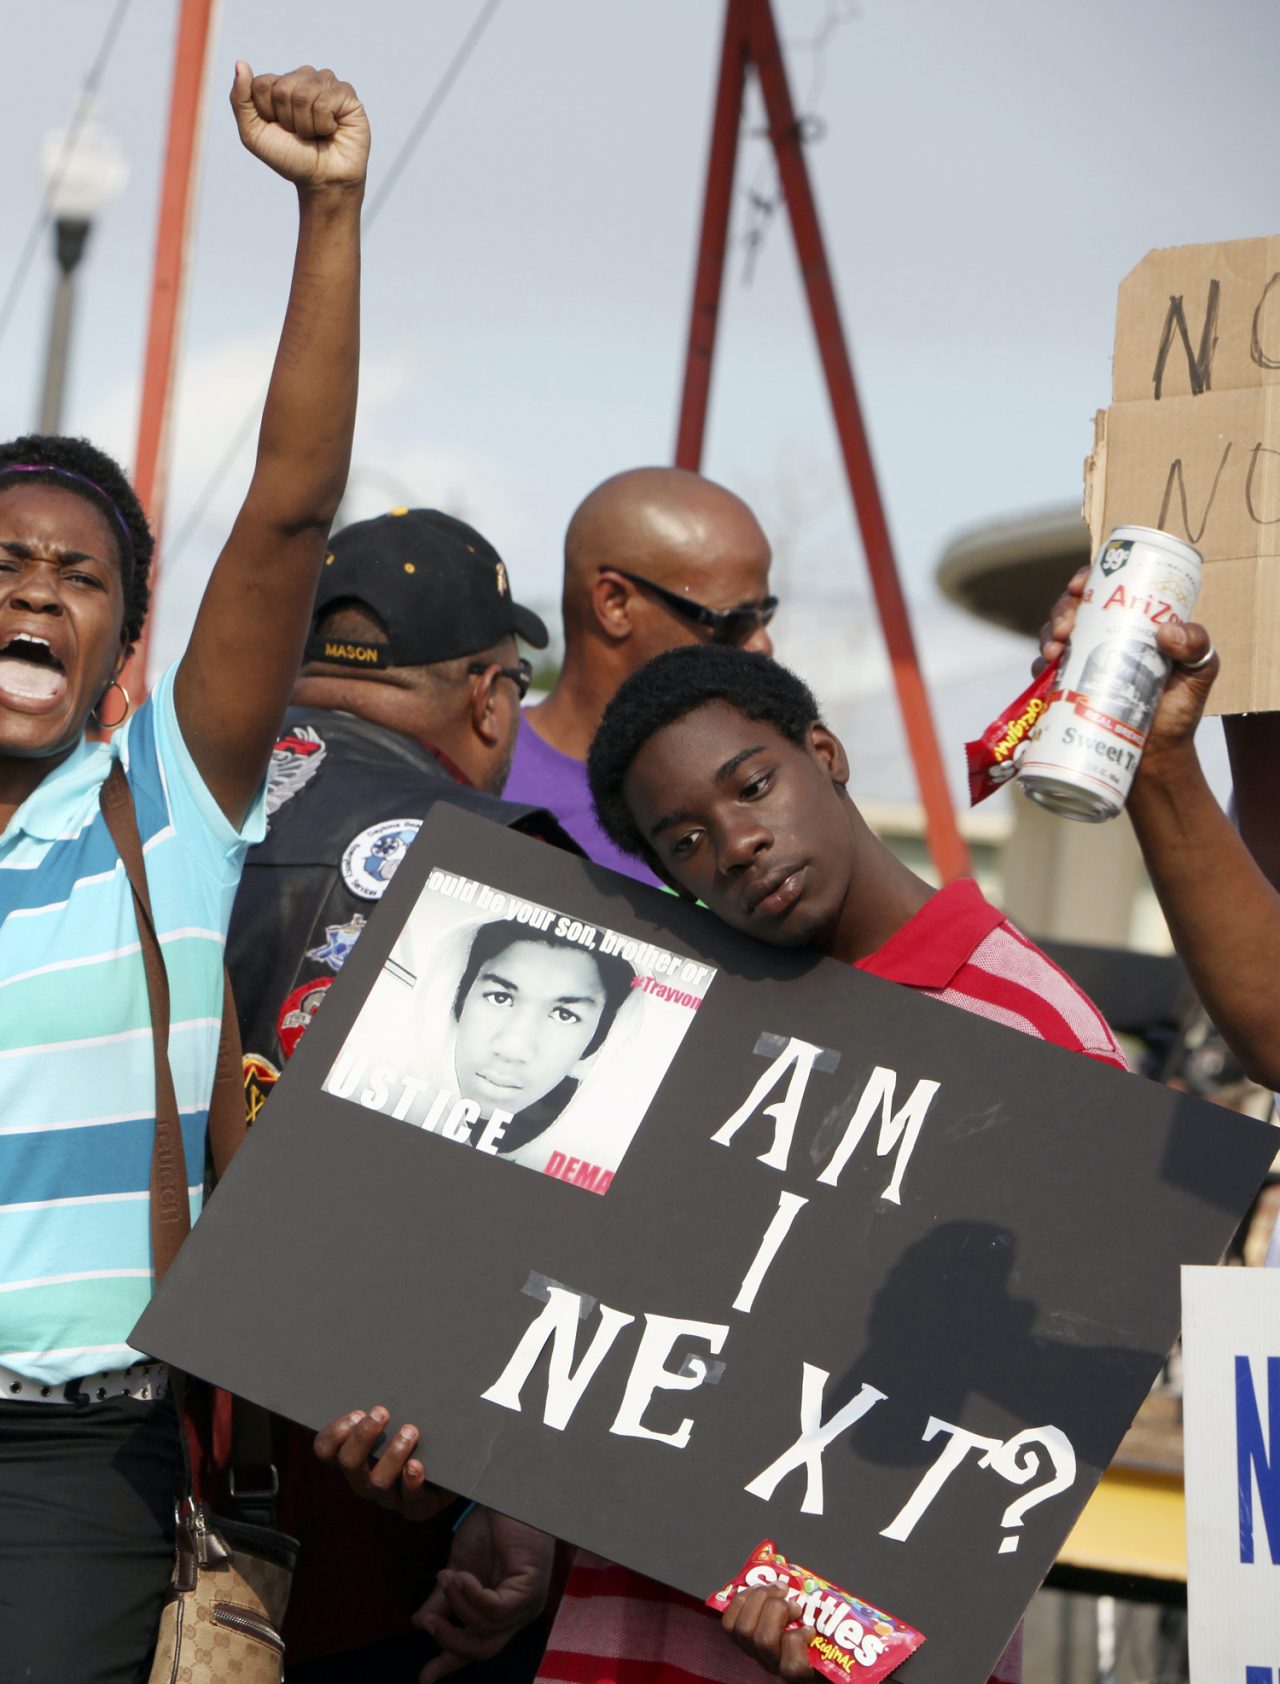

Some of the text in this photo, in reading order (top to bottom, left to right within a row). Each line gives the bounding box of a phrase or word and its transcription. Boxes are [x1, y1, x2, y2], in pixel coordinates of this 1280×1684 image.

[325, 642, 378, 664] MASON
[1062, 726, 1123, 767] Sweet
[427, 869, 710, 986] ould be your son, brother or
[629, 974, 703, 1012] #Trayvon
[710, 1036, 942, 1206] AM
[731, 1190, 810, 1314] I
[480, 1286, 1078, 1556] NEXT?
